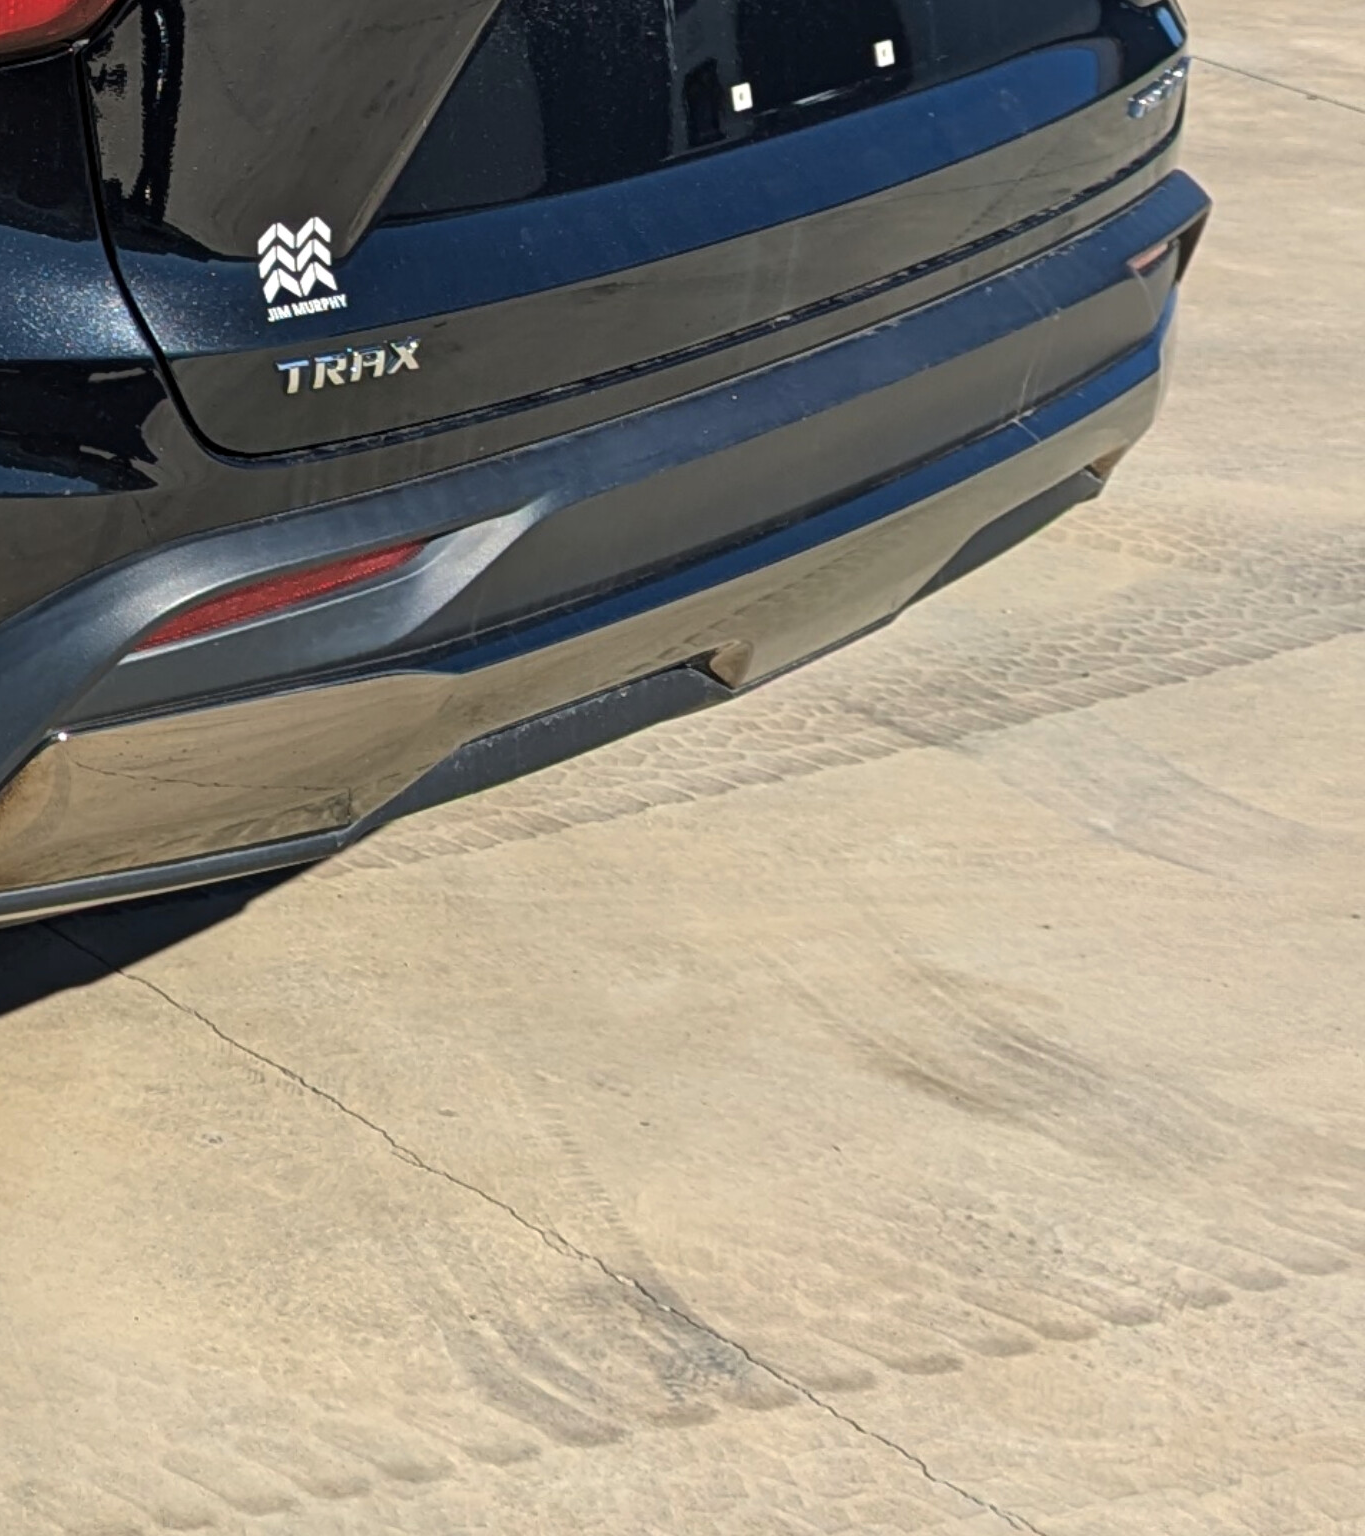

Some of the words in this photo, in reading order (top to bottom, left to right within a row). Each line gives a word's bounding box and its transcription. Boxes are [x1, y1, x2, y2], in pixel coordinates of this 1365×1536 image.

[267, 304, 293, 323] JIM
[291, 293, 348, 317] MURPHY
[274, 336, 420, 394] TRAX
